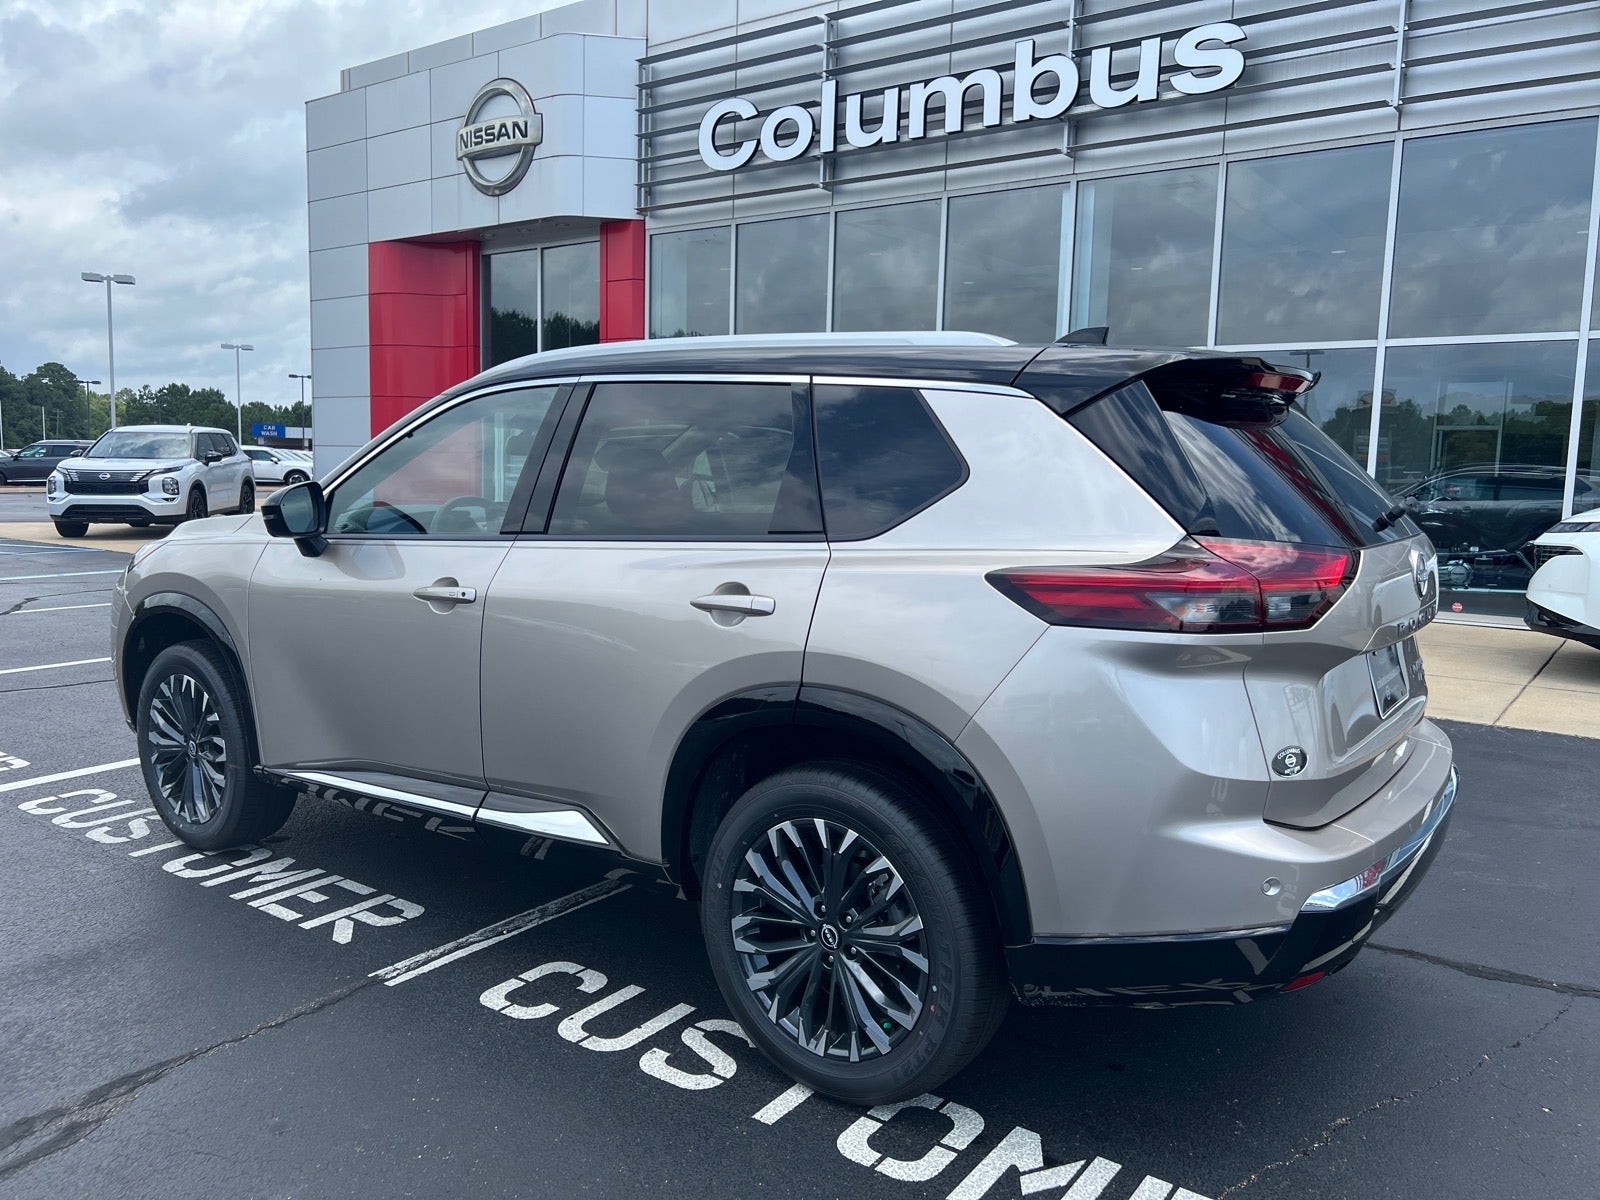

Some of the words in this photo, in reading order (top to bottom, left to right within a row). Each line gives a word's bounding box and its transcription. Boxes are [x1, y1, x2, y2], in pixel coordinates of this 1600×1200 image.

[459, 119, 529, 151] NISSAN
[699, 22, 1248, 172] Columbus
[480, 960, 1217, 1200] CUSOM
